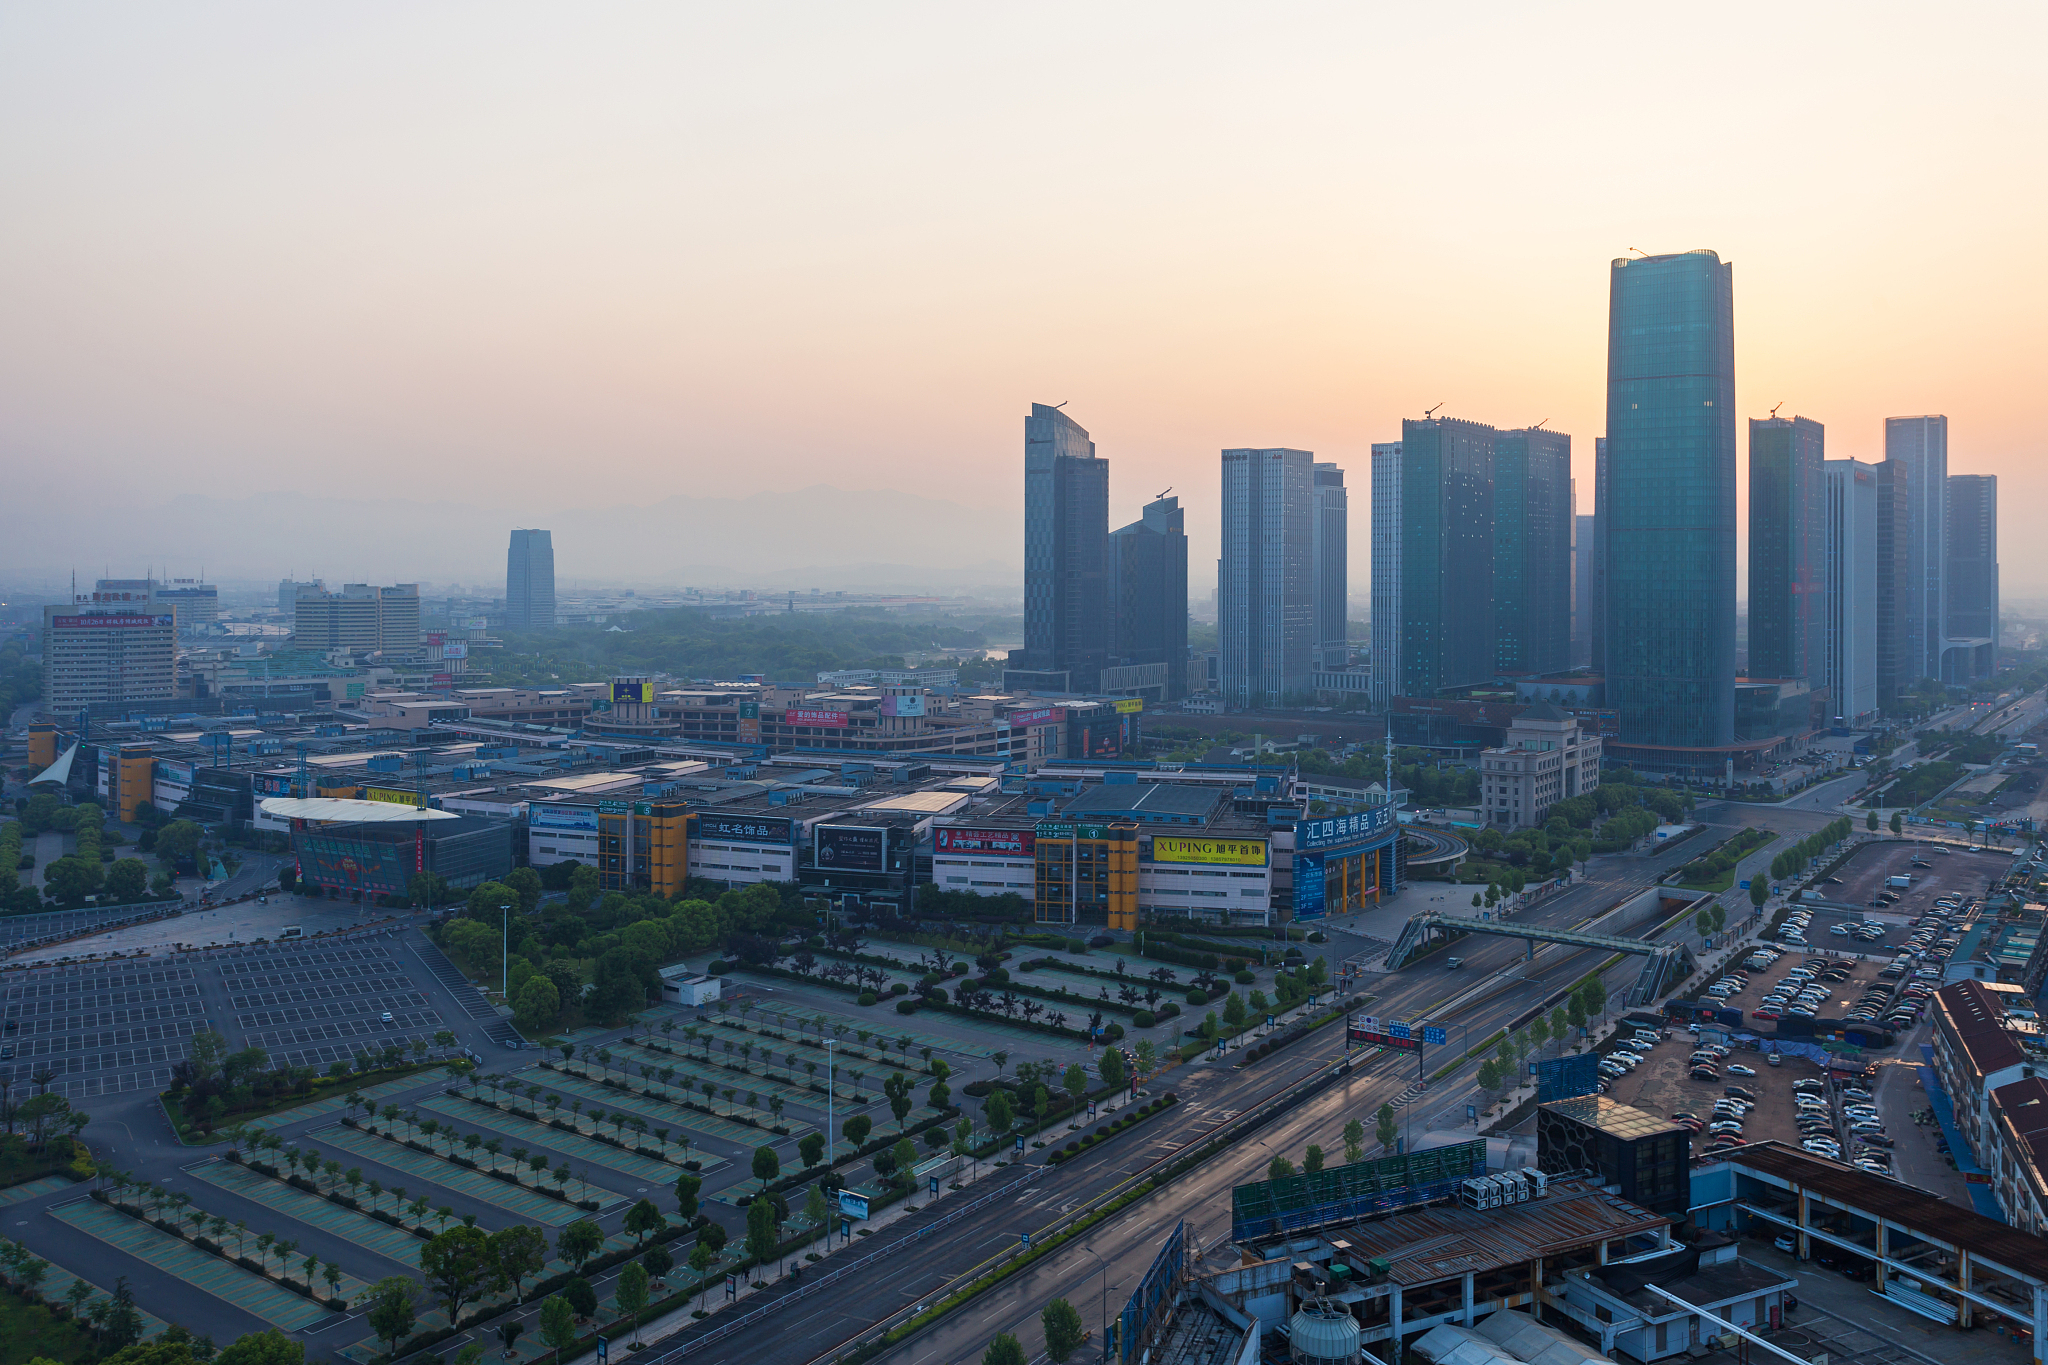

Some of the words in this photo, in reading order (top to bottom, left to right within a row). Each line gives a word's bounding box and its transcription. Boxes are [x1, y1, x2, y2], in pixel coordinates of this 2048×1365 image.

[369, 792, 397, 802] XUPING
[718, 822, 768, 836] 虹名饰品
[1306, 814, 1369, 839] 汇四海精品
[1158, 842, 1211, 853] XUPING
[1216, 844, 1260, 855] 旭平首饰
